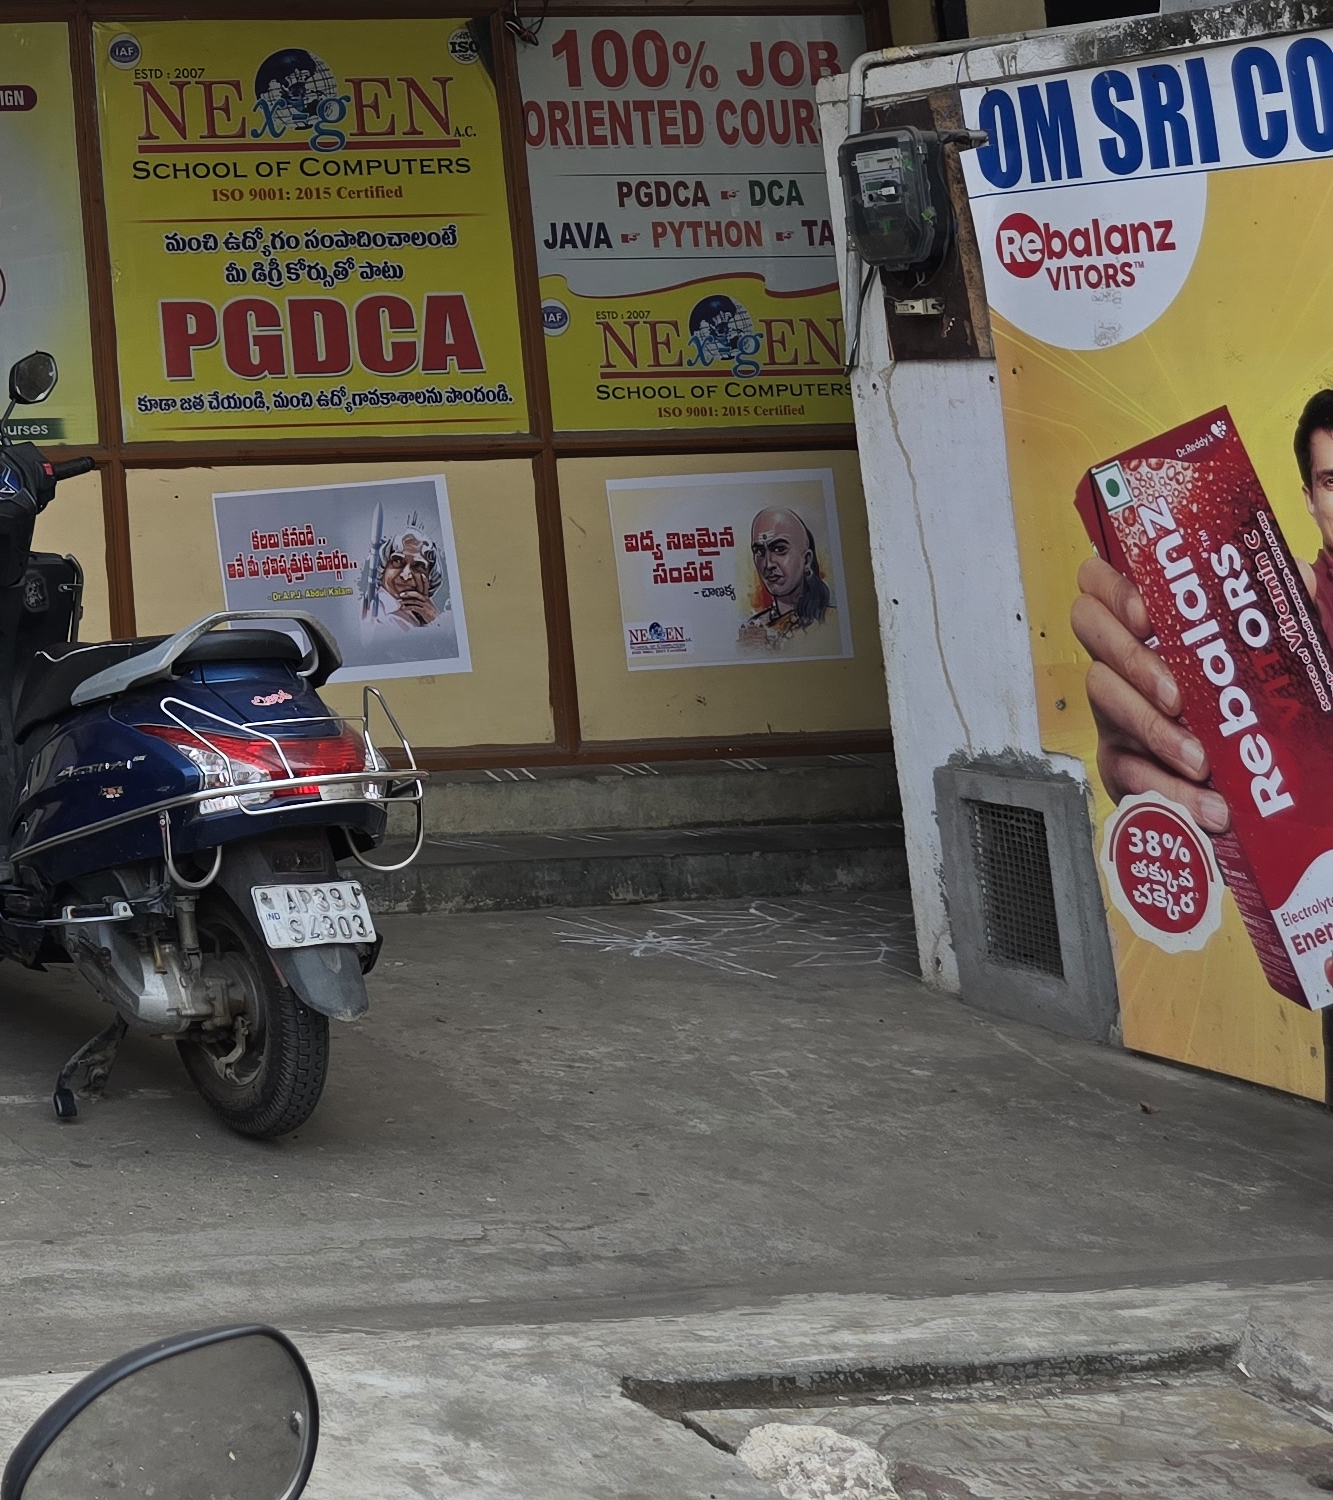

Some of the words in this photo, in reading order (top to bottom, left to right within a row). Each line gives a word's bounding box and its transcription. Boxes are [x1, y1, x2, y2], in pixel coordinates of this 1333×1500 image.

[552, 29, 718, 88] 100%
[737, 41, 841, 87] JOB
[976, 79, 1082, 189] OM
[1090, 57, 1220, 175] SRI
[618, 180, 710, 207] PGDCA
[749, 180, 803, 206] DCA
[544, 222, 612, 249] JAVA
[652, 220, 763, 247] PYTHON
[999, 218, 1176, 267] Rebalanz
[653, 561, 714, 584] సంపద
[1128, 827, 1190, 862] 38%
[1131, 860, 1193, 892] తక్కువ
